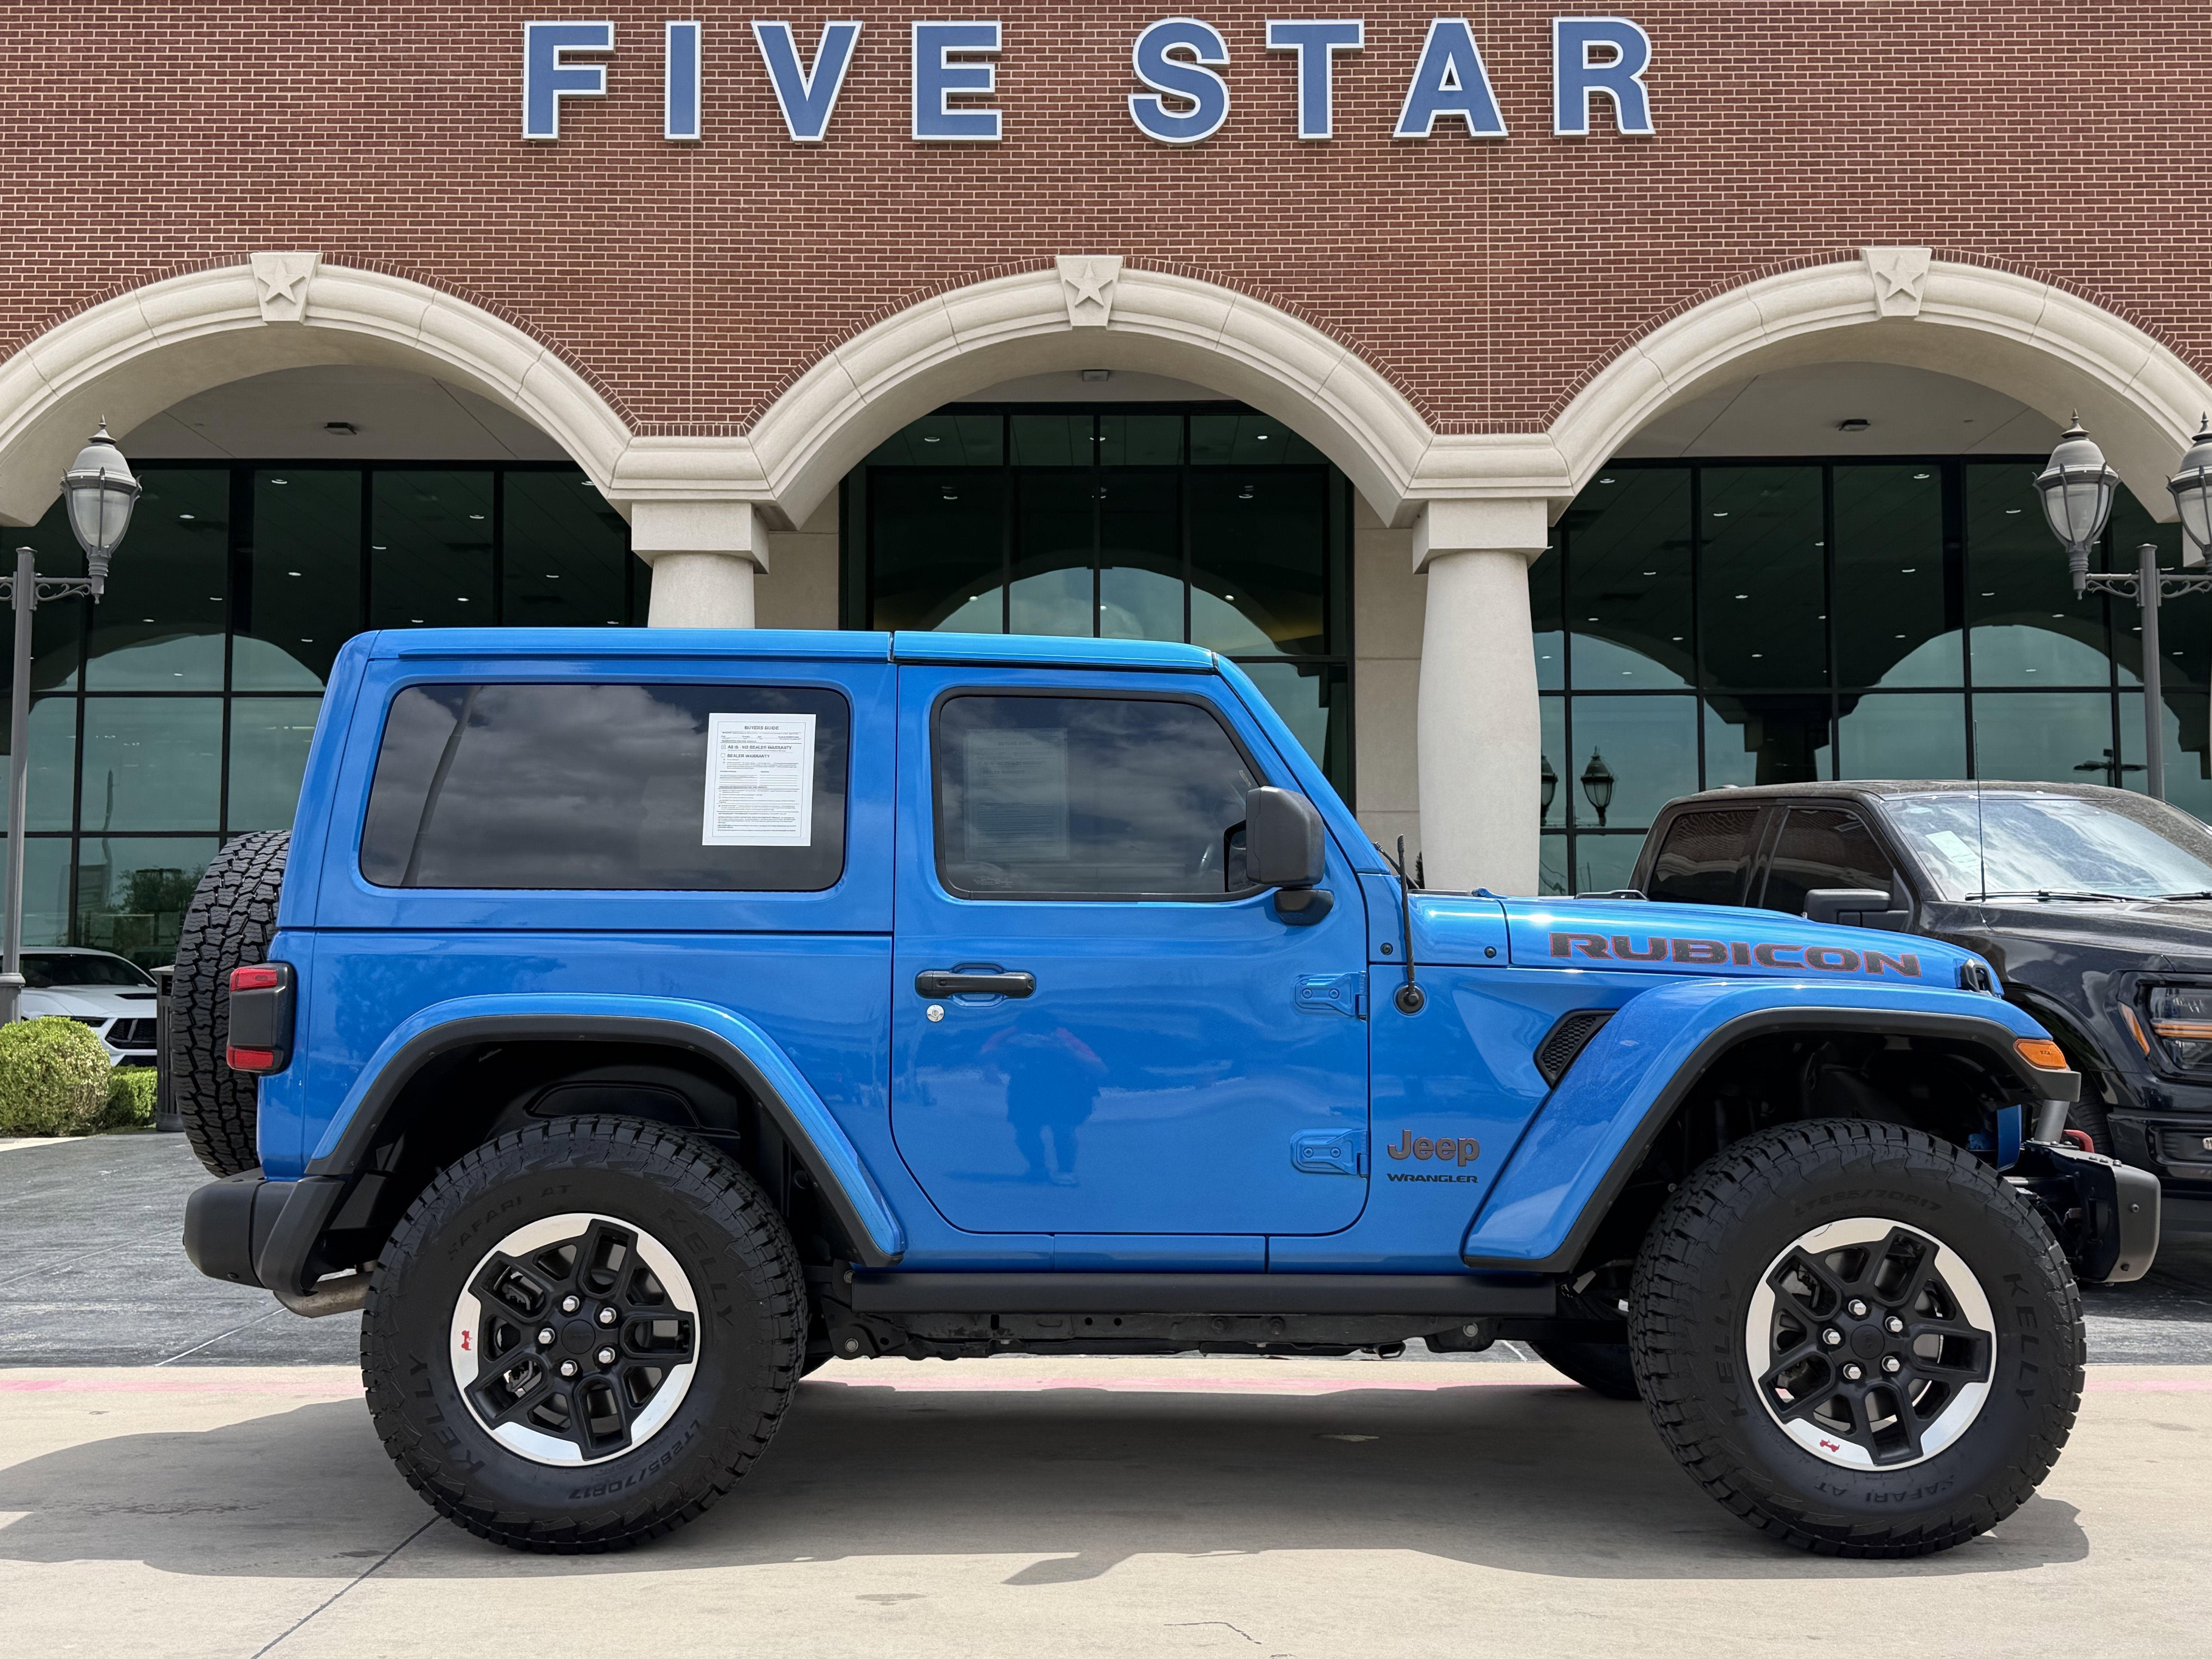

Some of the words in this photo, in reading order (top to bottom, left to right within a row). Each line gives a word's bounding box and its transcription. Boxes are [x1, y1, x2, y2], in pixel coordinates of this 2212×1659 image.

[522, 19, 1003, 144] FIVE
[1127, 16, 1656, 146] STAR
[1548, 931, 1922, 978] RUBICON
[1386, 1173, 1478, 1183] WRANGLER
[1387, 1129, 1480, 1167] Jeep
[447, 1195, 522, 1261] SAFARI
[540, 1184, 573, 1198] AT
[1792, 1188, 1943, 1218] LT285/70R17
[659, 1207, 735, 1328] KELLY
[1714, 1278, 1749, 1419] KELLY
[2002, 1273, 2040, 1411] KELLY
[408, 1352, 486, 1475] KELLY
[568, 1418, 701, 1500] LT285/70R17
[1814, 1482, 1848, 1497] AT
[1865, 1474, 1955, 1503] SAFARI
